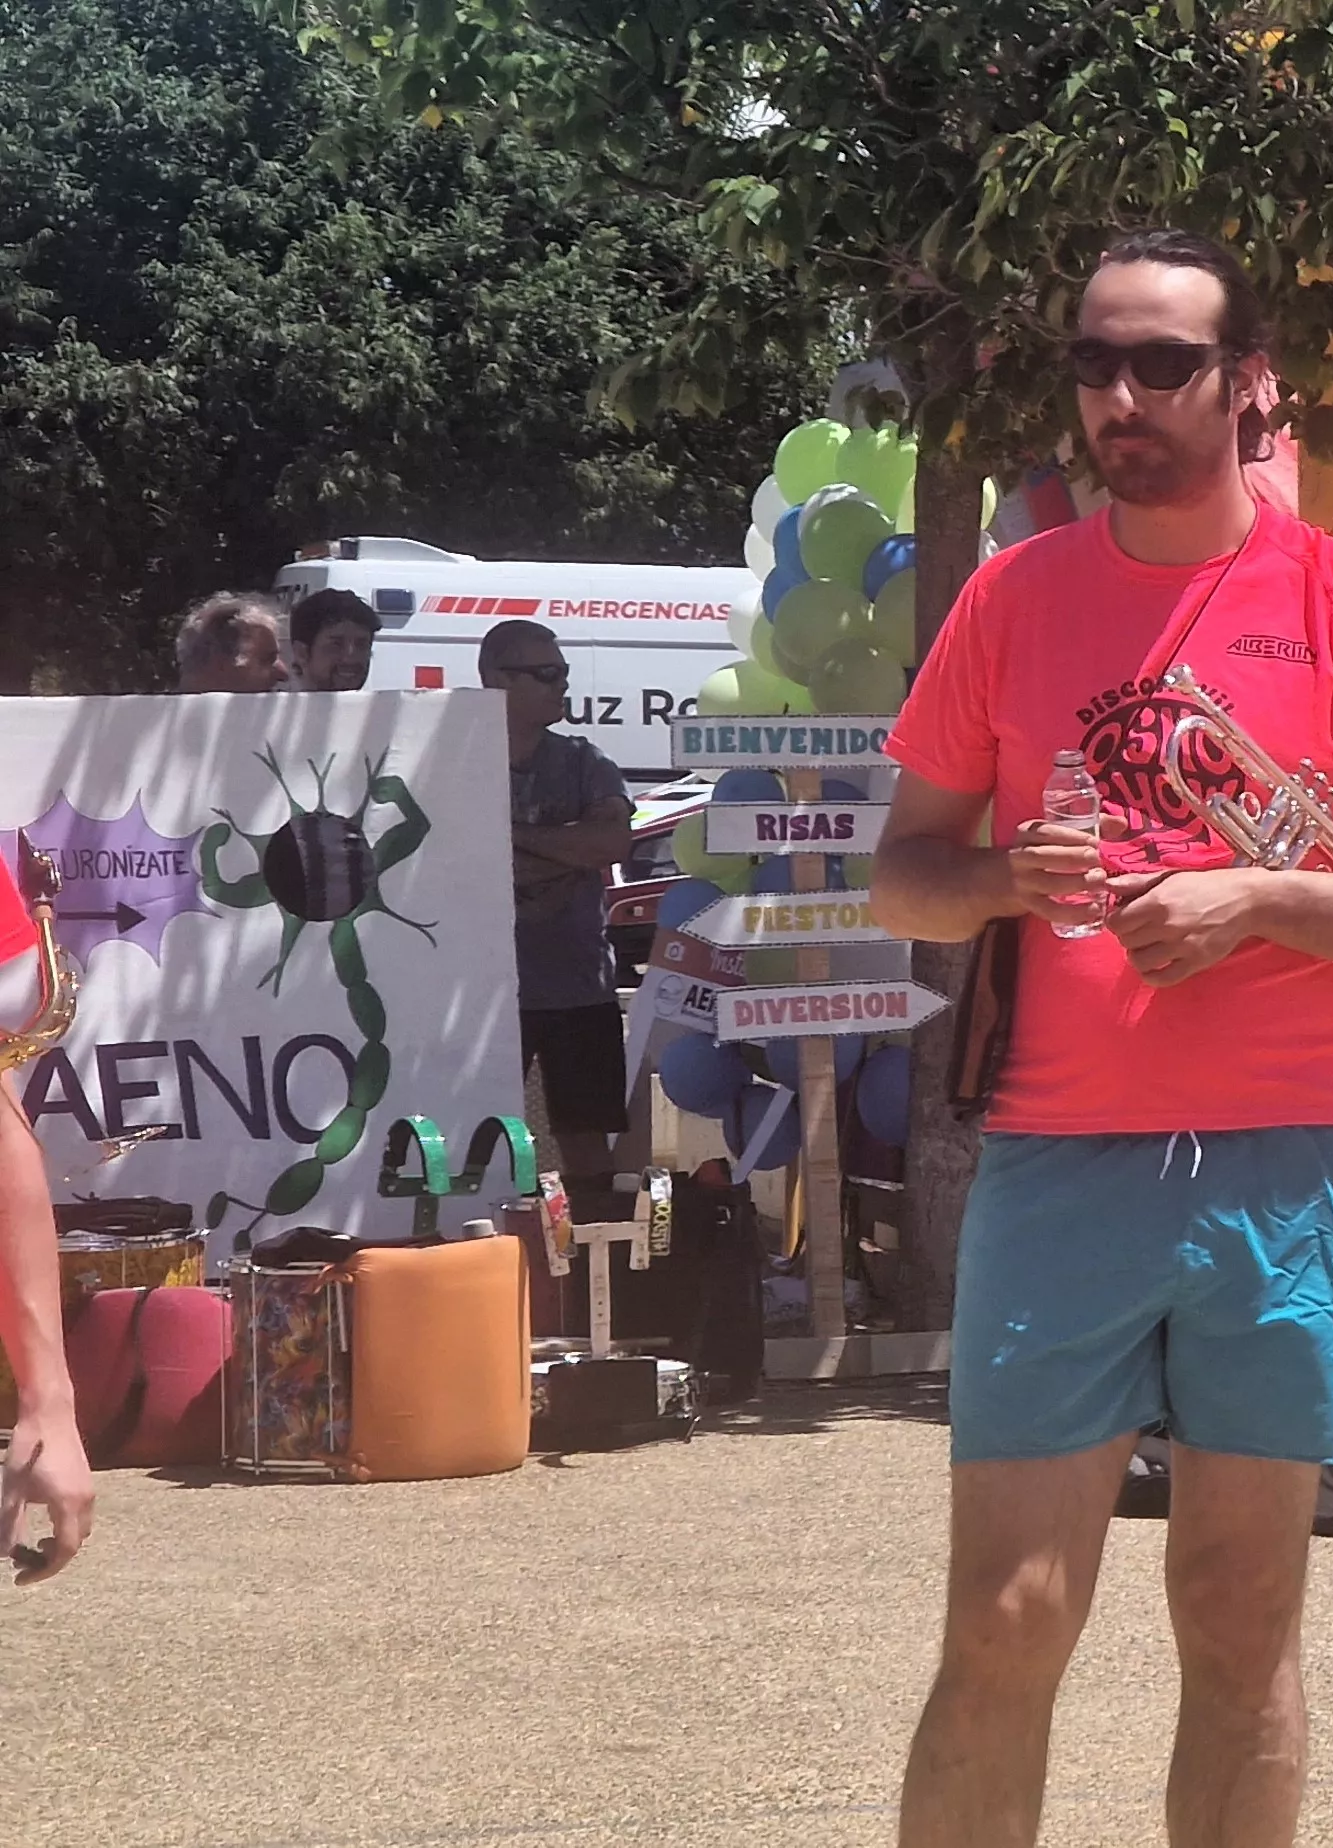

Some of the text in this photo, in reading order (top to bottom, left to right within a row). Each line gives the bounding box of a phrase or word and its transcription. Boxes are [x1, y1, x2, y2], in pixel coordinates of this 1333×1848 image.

[548, 600, 732, 621] EMERGENCIAS
[755, 813, 854, 841] RISAS
[733, 992, 908, 1027] DIVERSION
